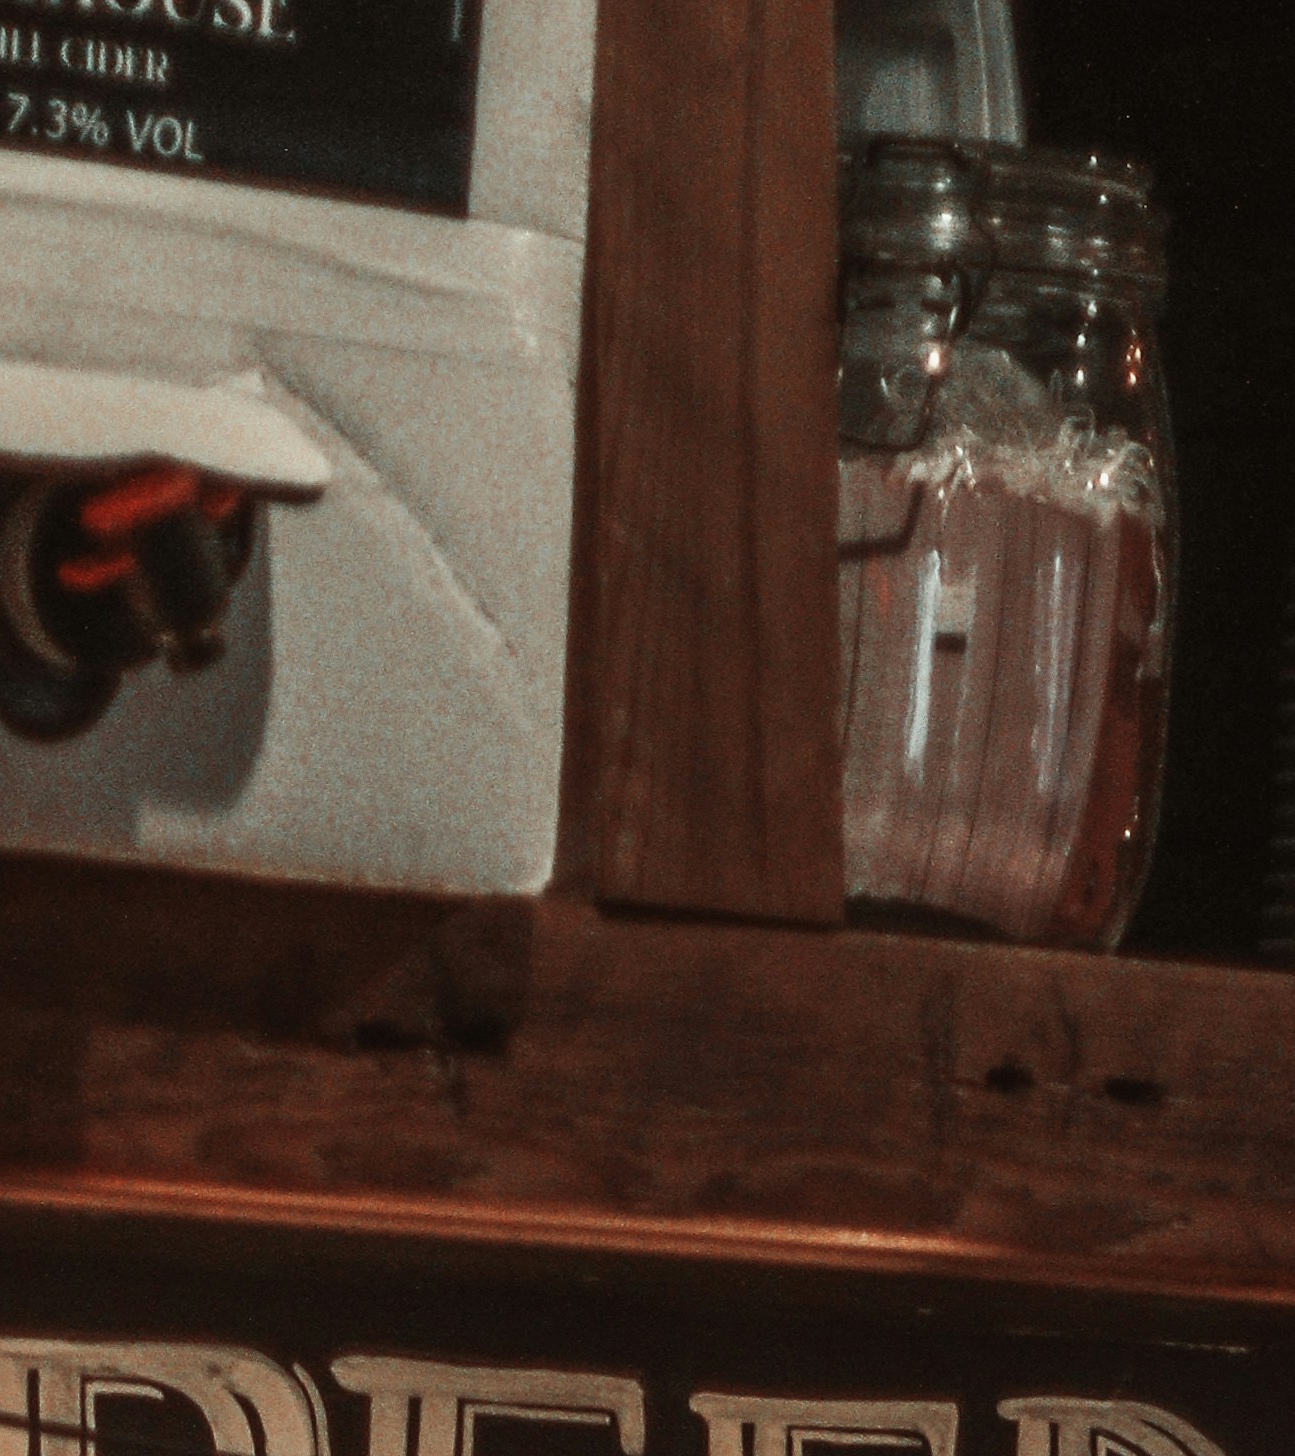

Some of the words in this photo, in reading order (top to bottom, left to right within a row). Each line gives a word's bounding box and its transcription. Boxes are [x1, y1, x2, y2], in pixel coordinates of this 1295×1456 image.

[60, 38, 169, 82] CIDER
[6, 91, 108, 146] 7.3%
[126, 108, 203, 161] VOL
